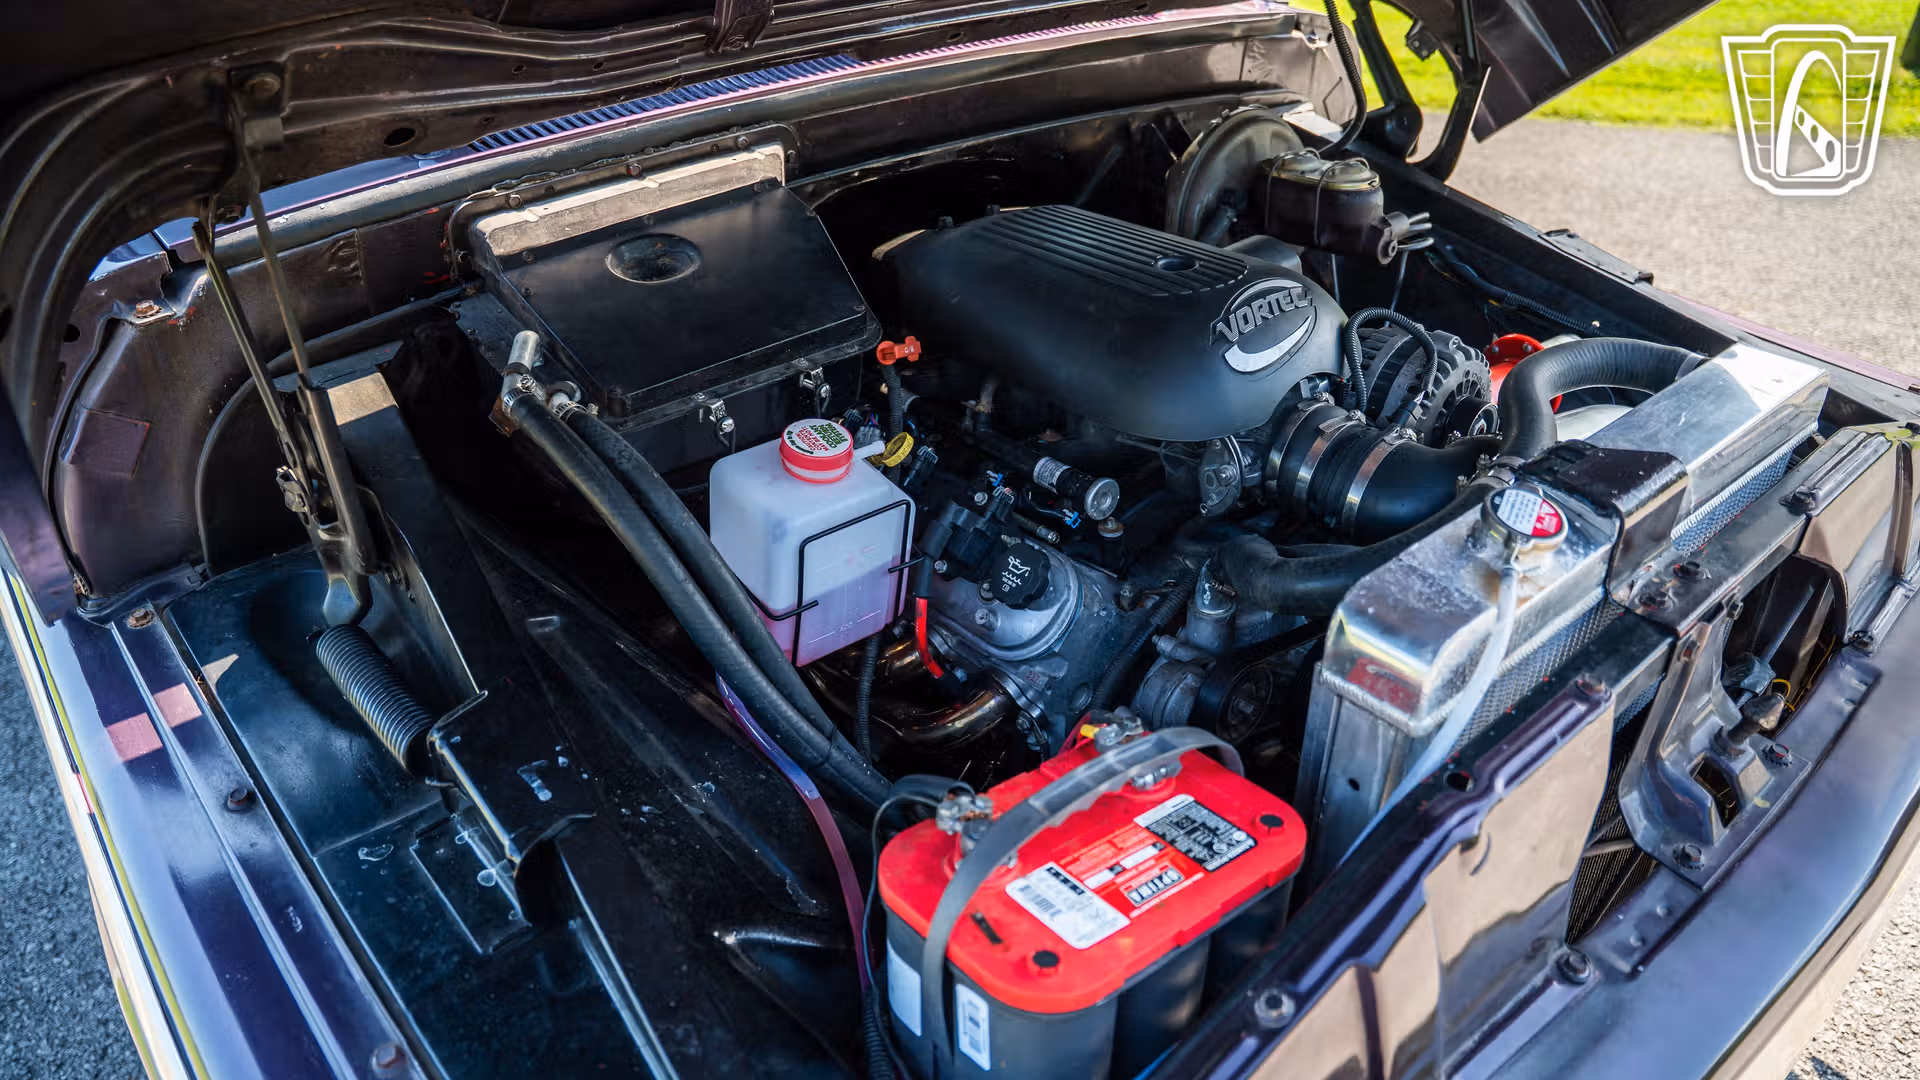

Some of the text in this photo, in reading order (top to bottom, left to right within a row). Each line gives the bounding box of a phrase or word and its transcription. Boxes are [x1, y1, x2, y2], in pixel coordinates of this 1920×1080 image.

[1216, 287, 1309, 342] VORTEC
[809, 424, 838, 448] COOLANT
[818, 424, 843, 445] RETURN
[825, 422, 849, 441] SYSTEM
[1128, 869, 1180, 904] OPTIMA
